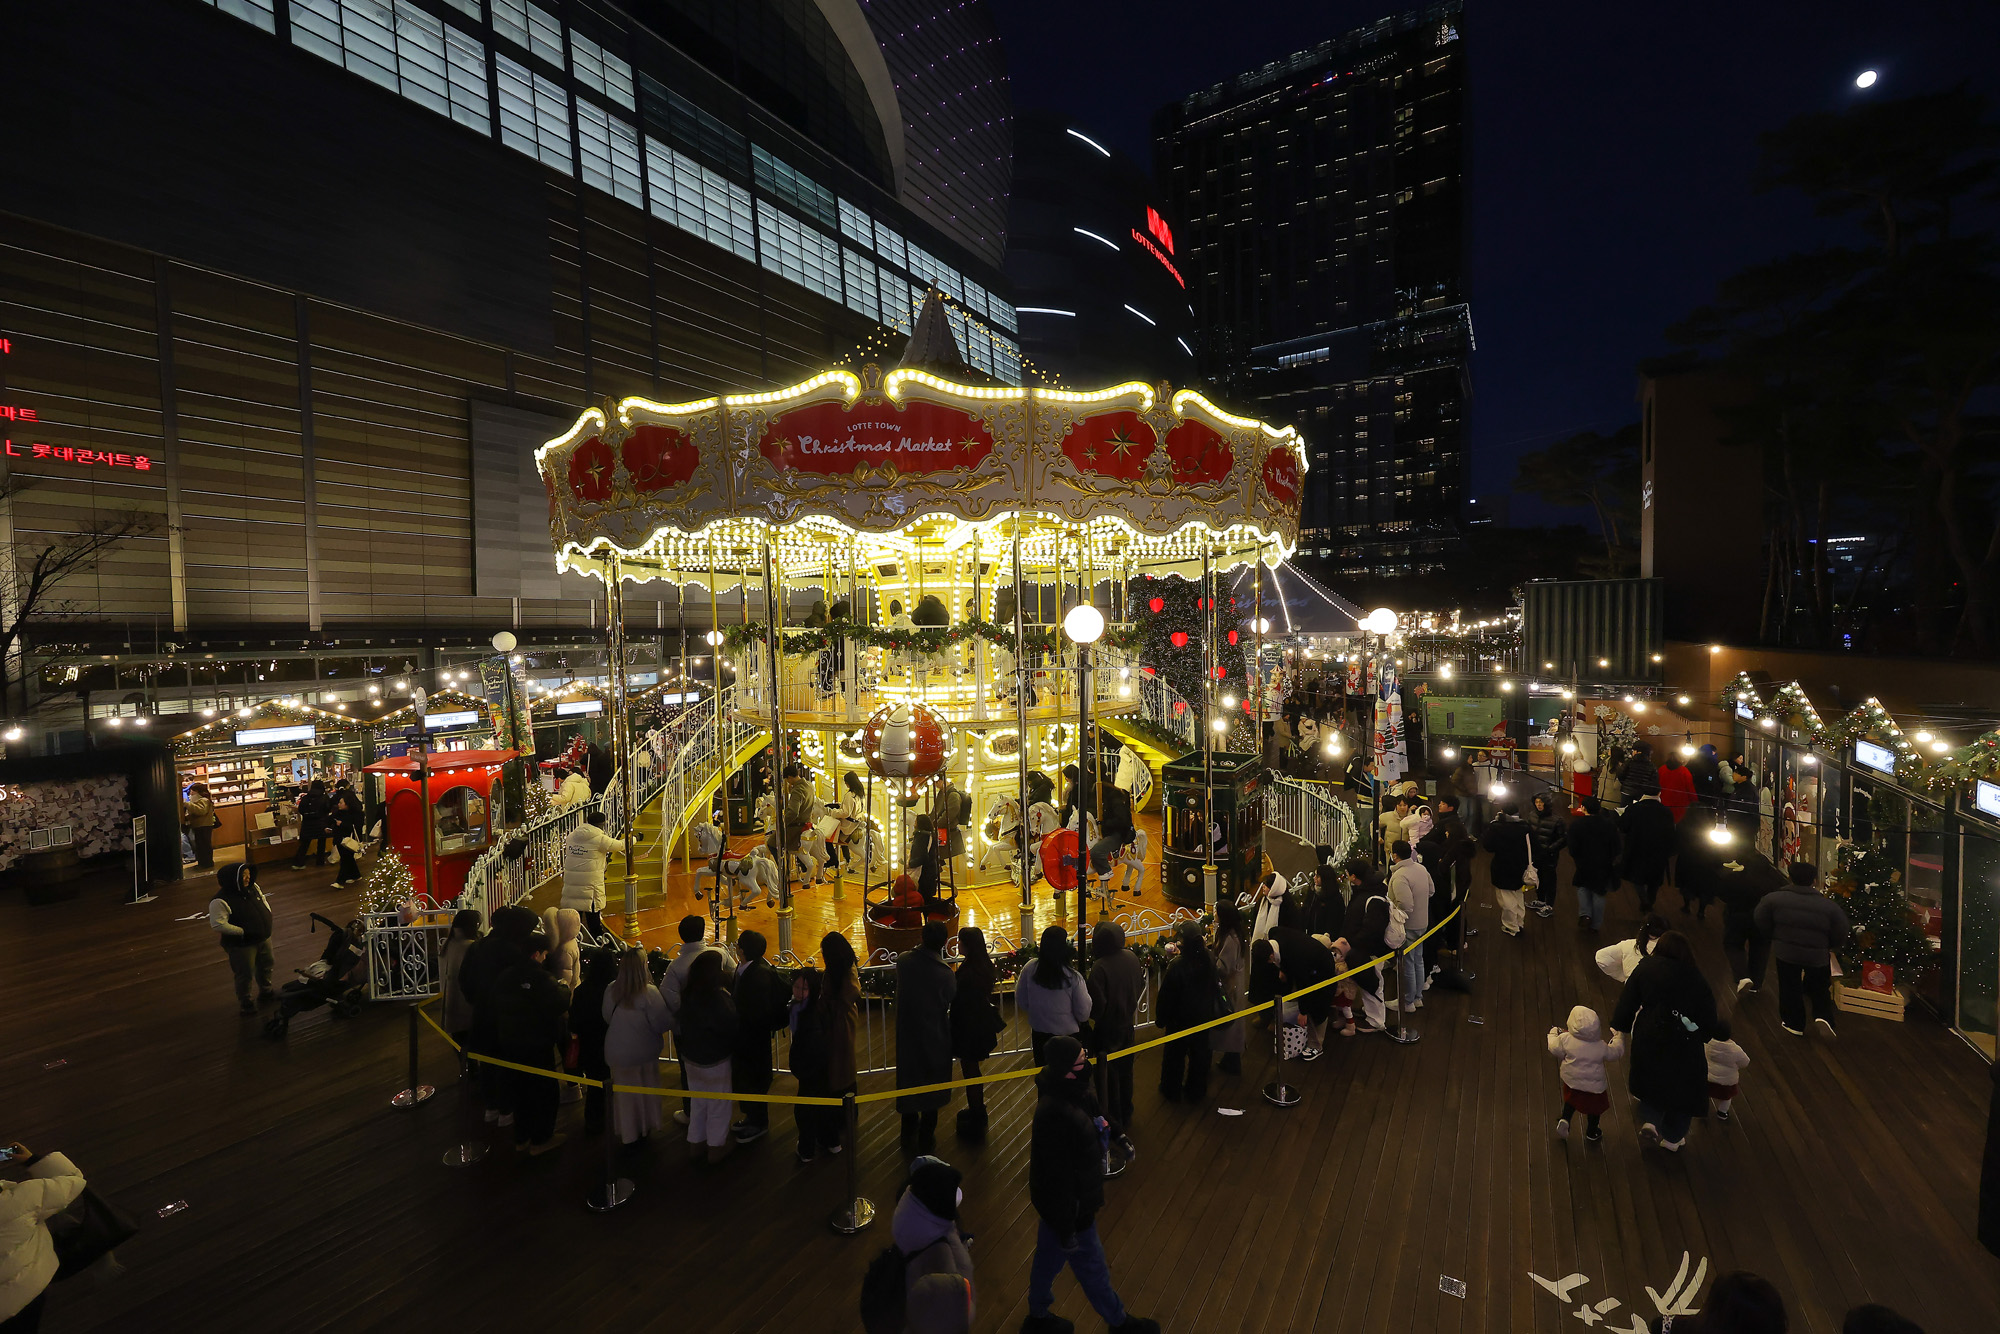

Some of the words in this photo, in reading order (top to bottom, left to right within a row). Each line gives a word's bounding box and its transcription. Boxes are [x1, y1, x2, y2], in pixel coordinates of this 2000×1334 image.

[1131, 228, 1155, 255] LOTTE
[0, 405, 40, 422] 마트
[847, 422, 872, 432] LOTTE
[875, 422, 901, 432] TOWN
[797, 435, 892, 454] Christmas
[895, 436, 953, 452] Market
[31, 443, 151, 471] 롯데콘서트홀
